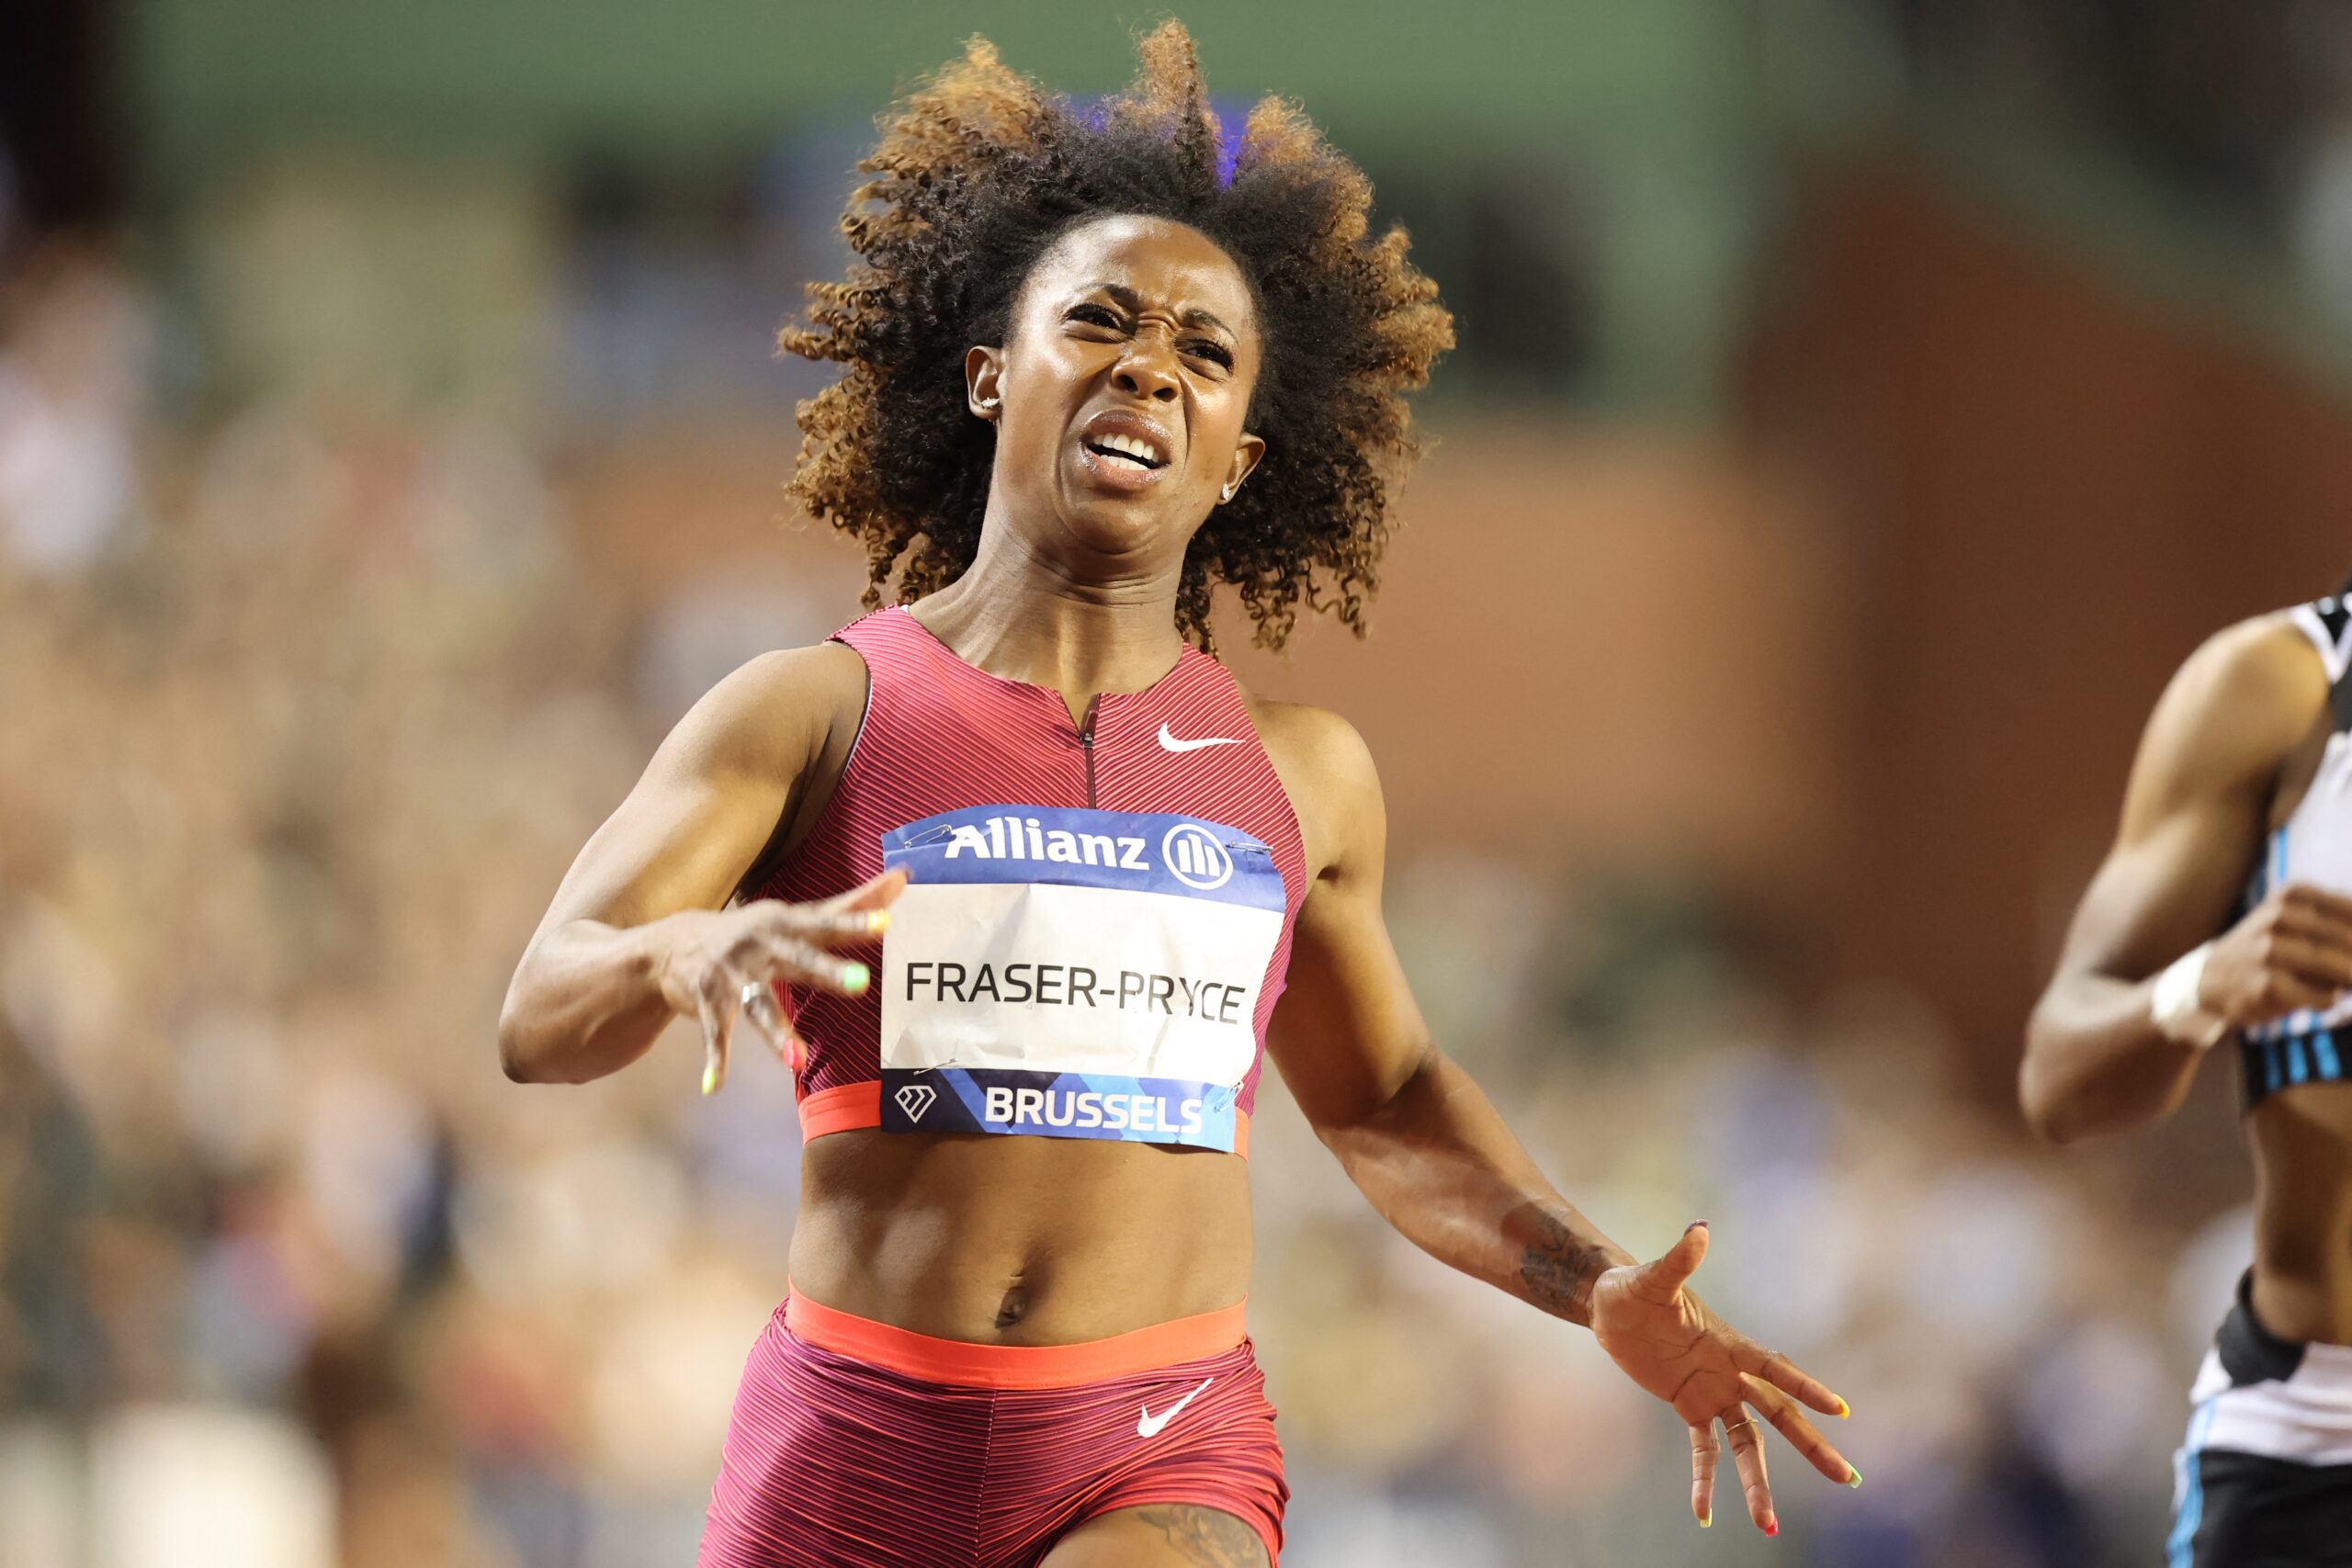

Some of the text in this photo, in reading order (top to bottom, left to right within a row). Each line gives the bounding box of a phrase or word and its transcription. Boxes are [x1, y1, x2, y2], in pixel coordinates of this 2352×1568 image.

[944, 817, 1150, 871] Allianz
[906, 962, 1247, 1025] FRASER-PRYCE
[985, 1086, 1204, 1134] BRUSSELS
